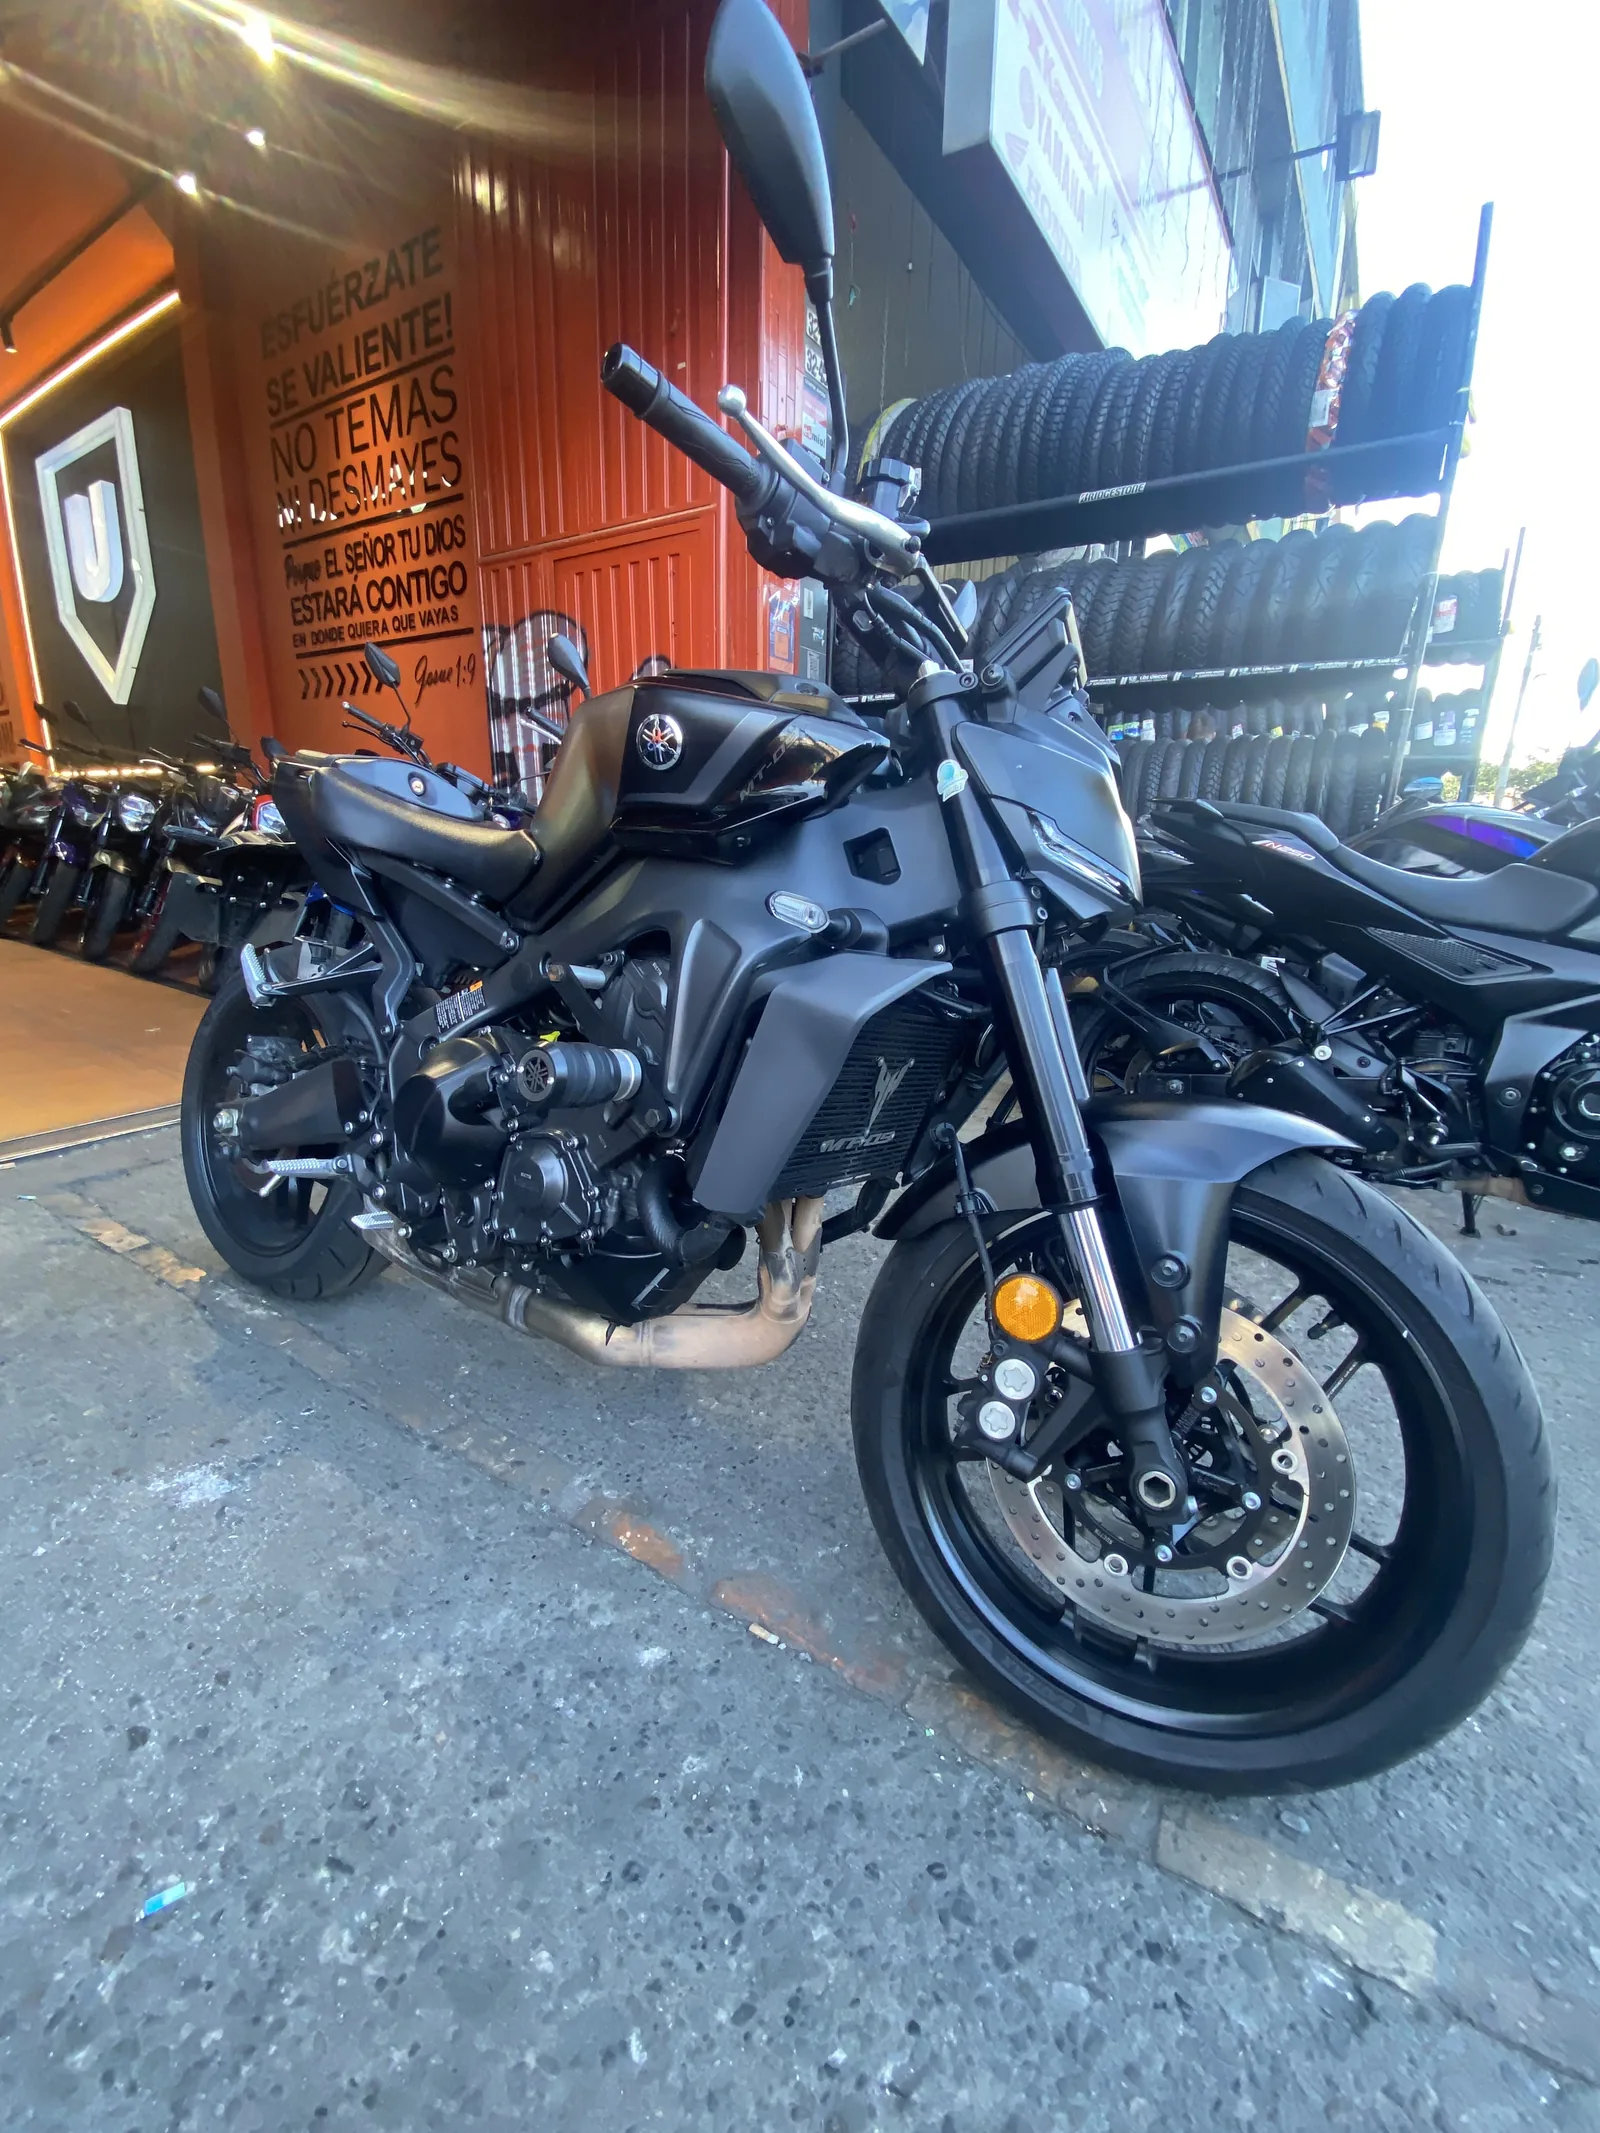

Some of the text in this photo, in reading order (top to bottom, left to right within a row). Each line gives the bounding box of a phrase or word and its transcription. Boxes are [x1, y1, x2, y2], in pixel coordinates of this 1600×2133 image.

[266, 292, 454, 418] SE VALIENTE!
[270, 364, 458, 483] NO TEMAS
[276, 430, 463, 535] NI DESMAYES
[1079, 482, 1147, 504] BRIDGESTONE
[324, 547, 343, 579] EL
[345, 532, 397, 575] SEÑOR
[398, 526, 421, 562] TU
[424, 514, 467, 557] DIOS
[290, 561, 468, 626] ESTARÁ CONTIGO
[292, 605, 459, 648] EN DONDE QUIERA QUE VAYAS
